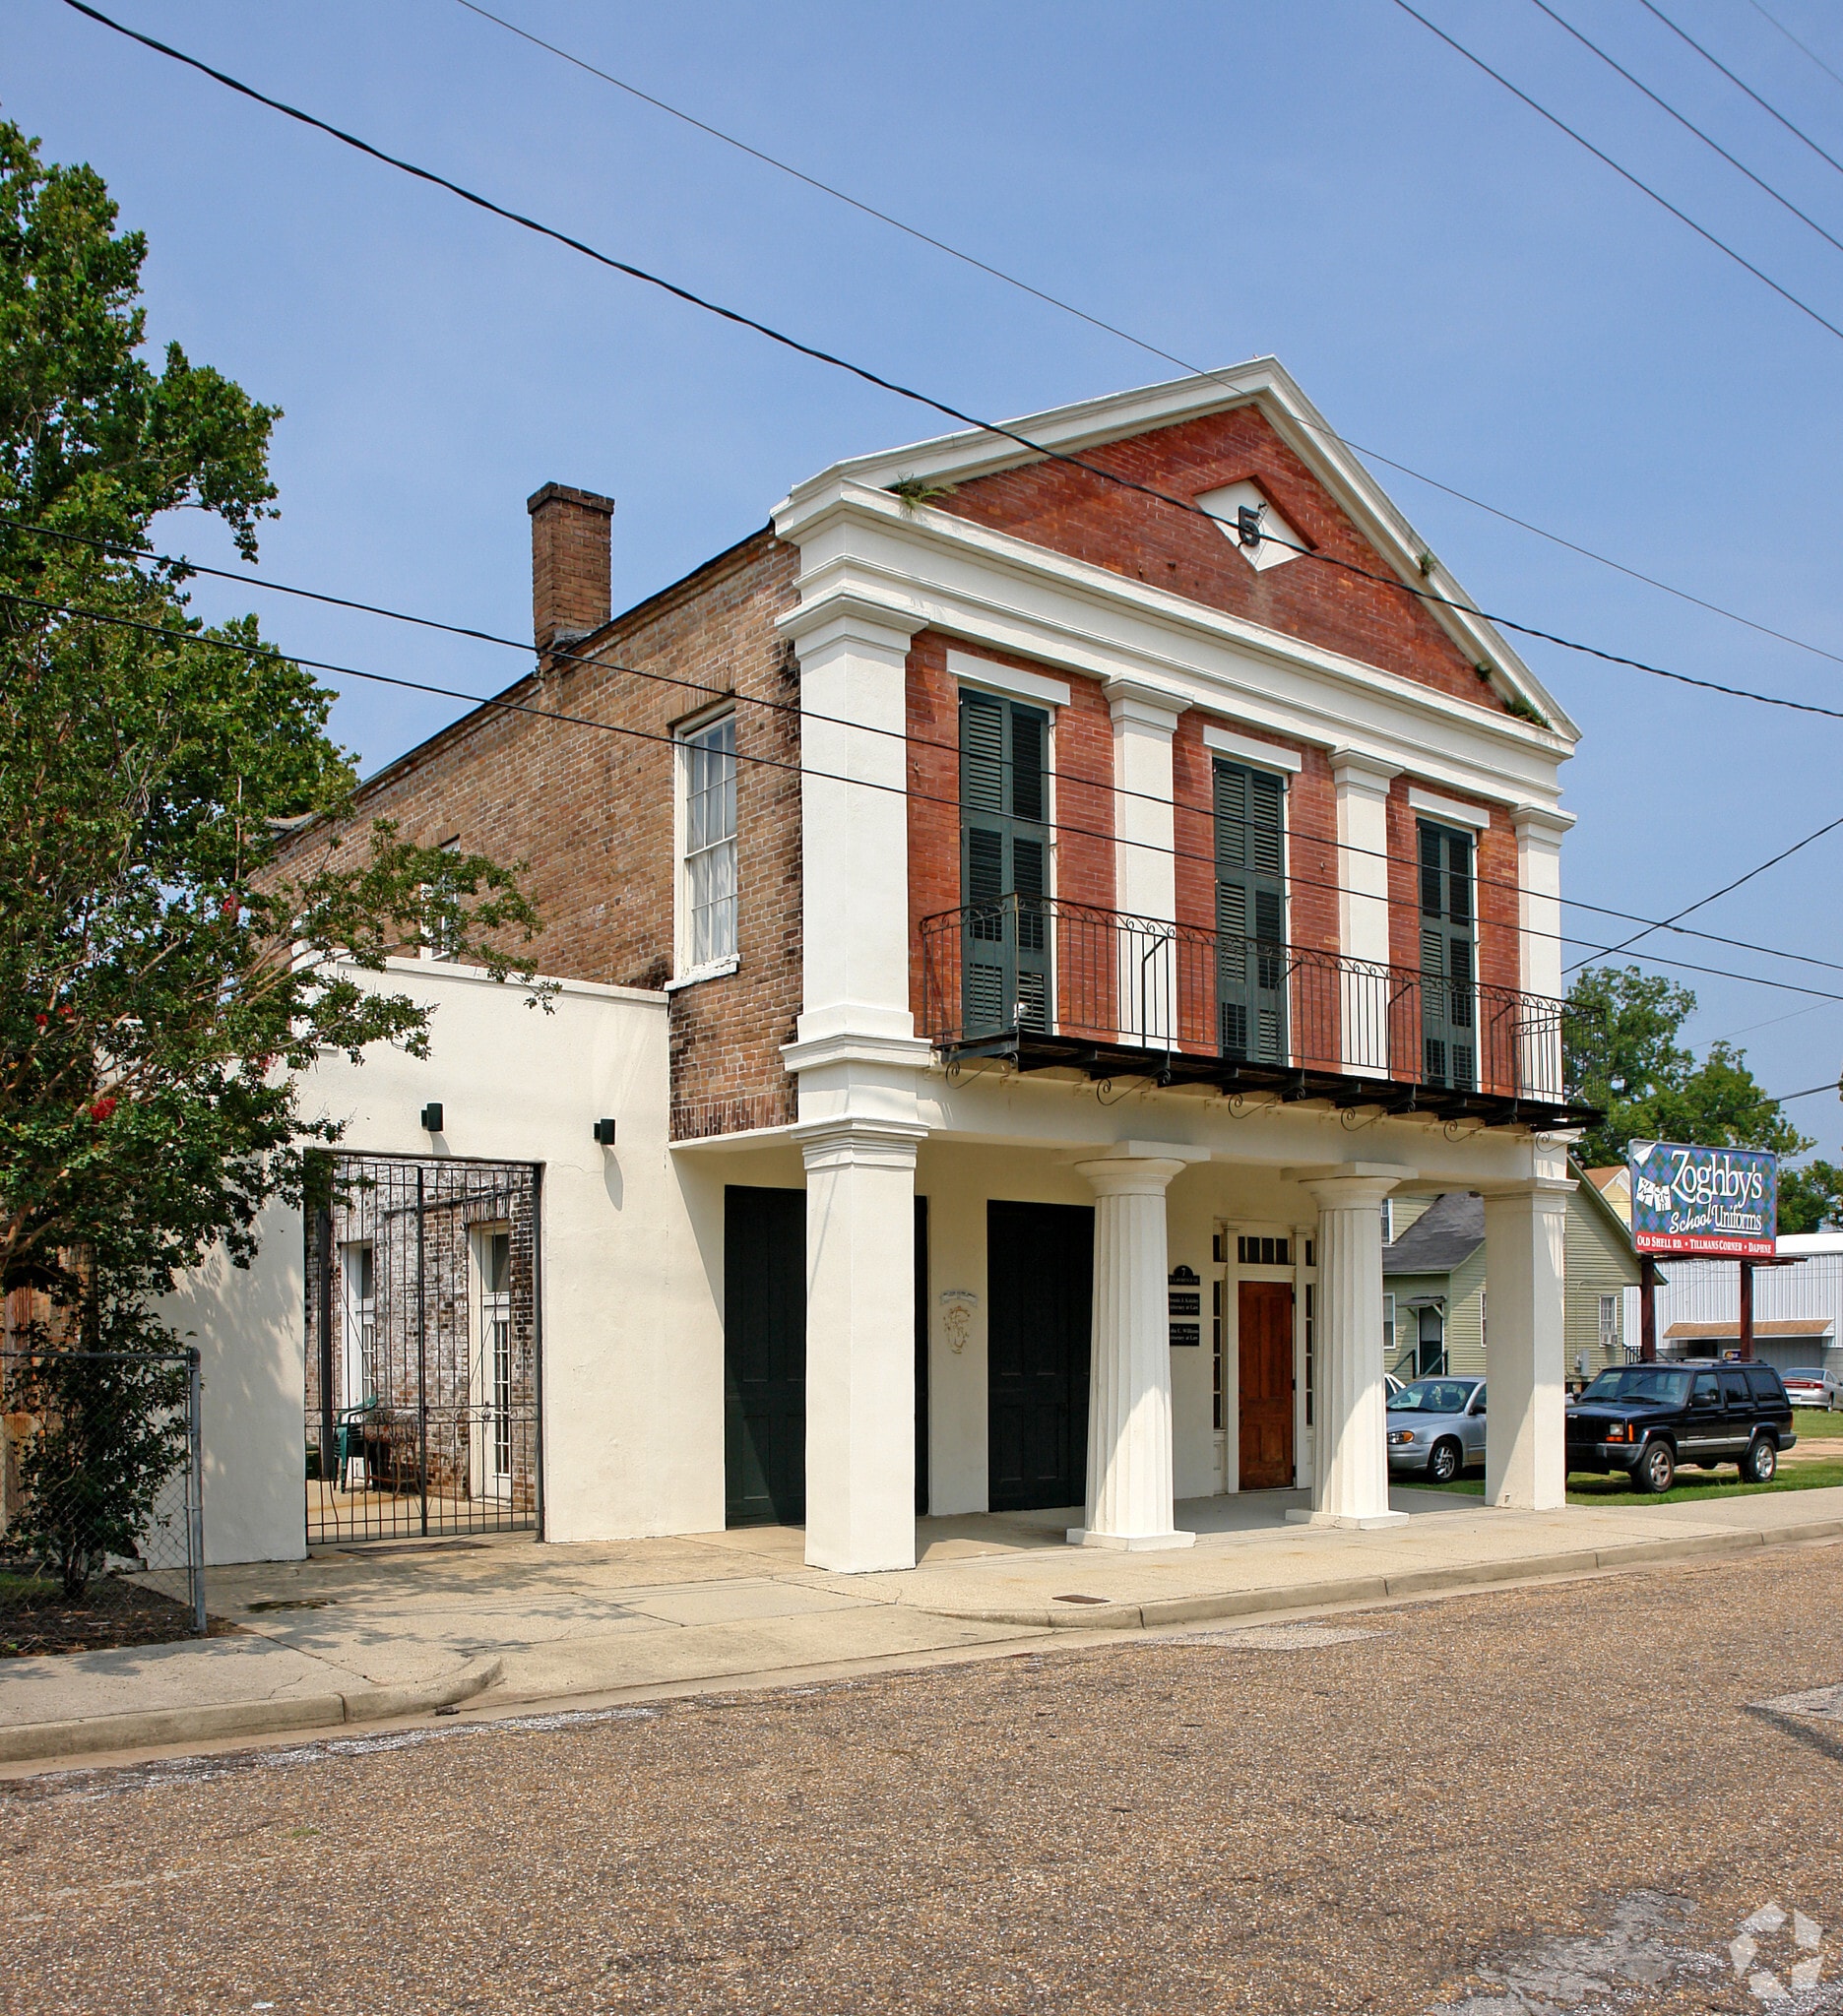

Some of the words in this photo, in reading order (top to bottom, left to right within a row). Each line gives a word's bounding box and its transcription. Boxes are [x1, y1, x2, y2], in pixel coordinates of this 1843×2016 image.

[1671, 1150, 1762, 1208] Zoghby's
[1669, 1203, 1712, 1234] School
[1711, 1203, 1762, 1230] Uniforms
[1636, 1234, 1649, 1246] OLD
[1651, 1235, 1672, 1249] SHELL
[1689, 1238, 1719, 1250] TILLMANS
[1719, 1240, 1743, 1251] CORNER
[1748, 1242, 1772, 1254] DAPHNE
